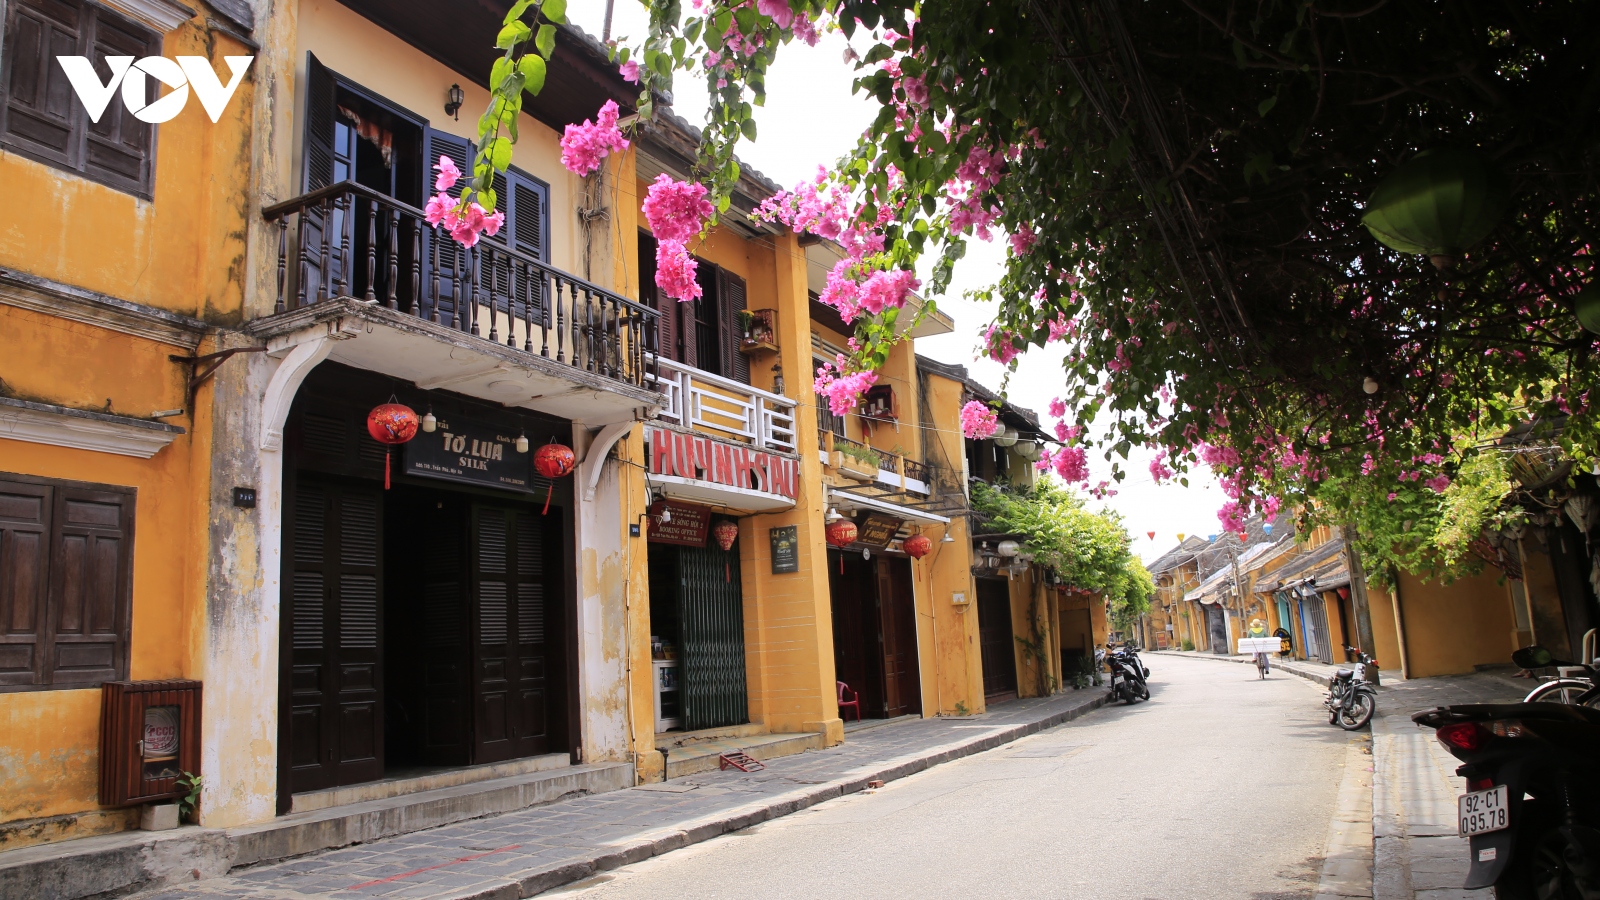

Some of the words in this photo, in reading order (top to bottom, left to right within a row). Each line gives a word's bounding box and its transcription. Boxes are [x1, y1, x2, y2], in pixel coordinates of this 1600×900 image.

[458, 456, 488, 471] SILK
[659, 525, 680, 534] BOOKING
[680, 528, 698, 537] OFFICE
[1466, 790, 1499, 813] 92-C1
[1462, 809, 1505, 834] 095.78
